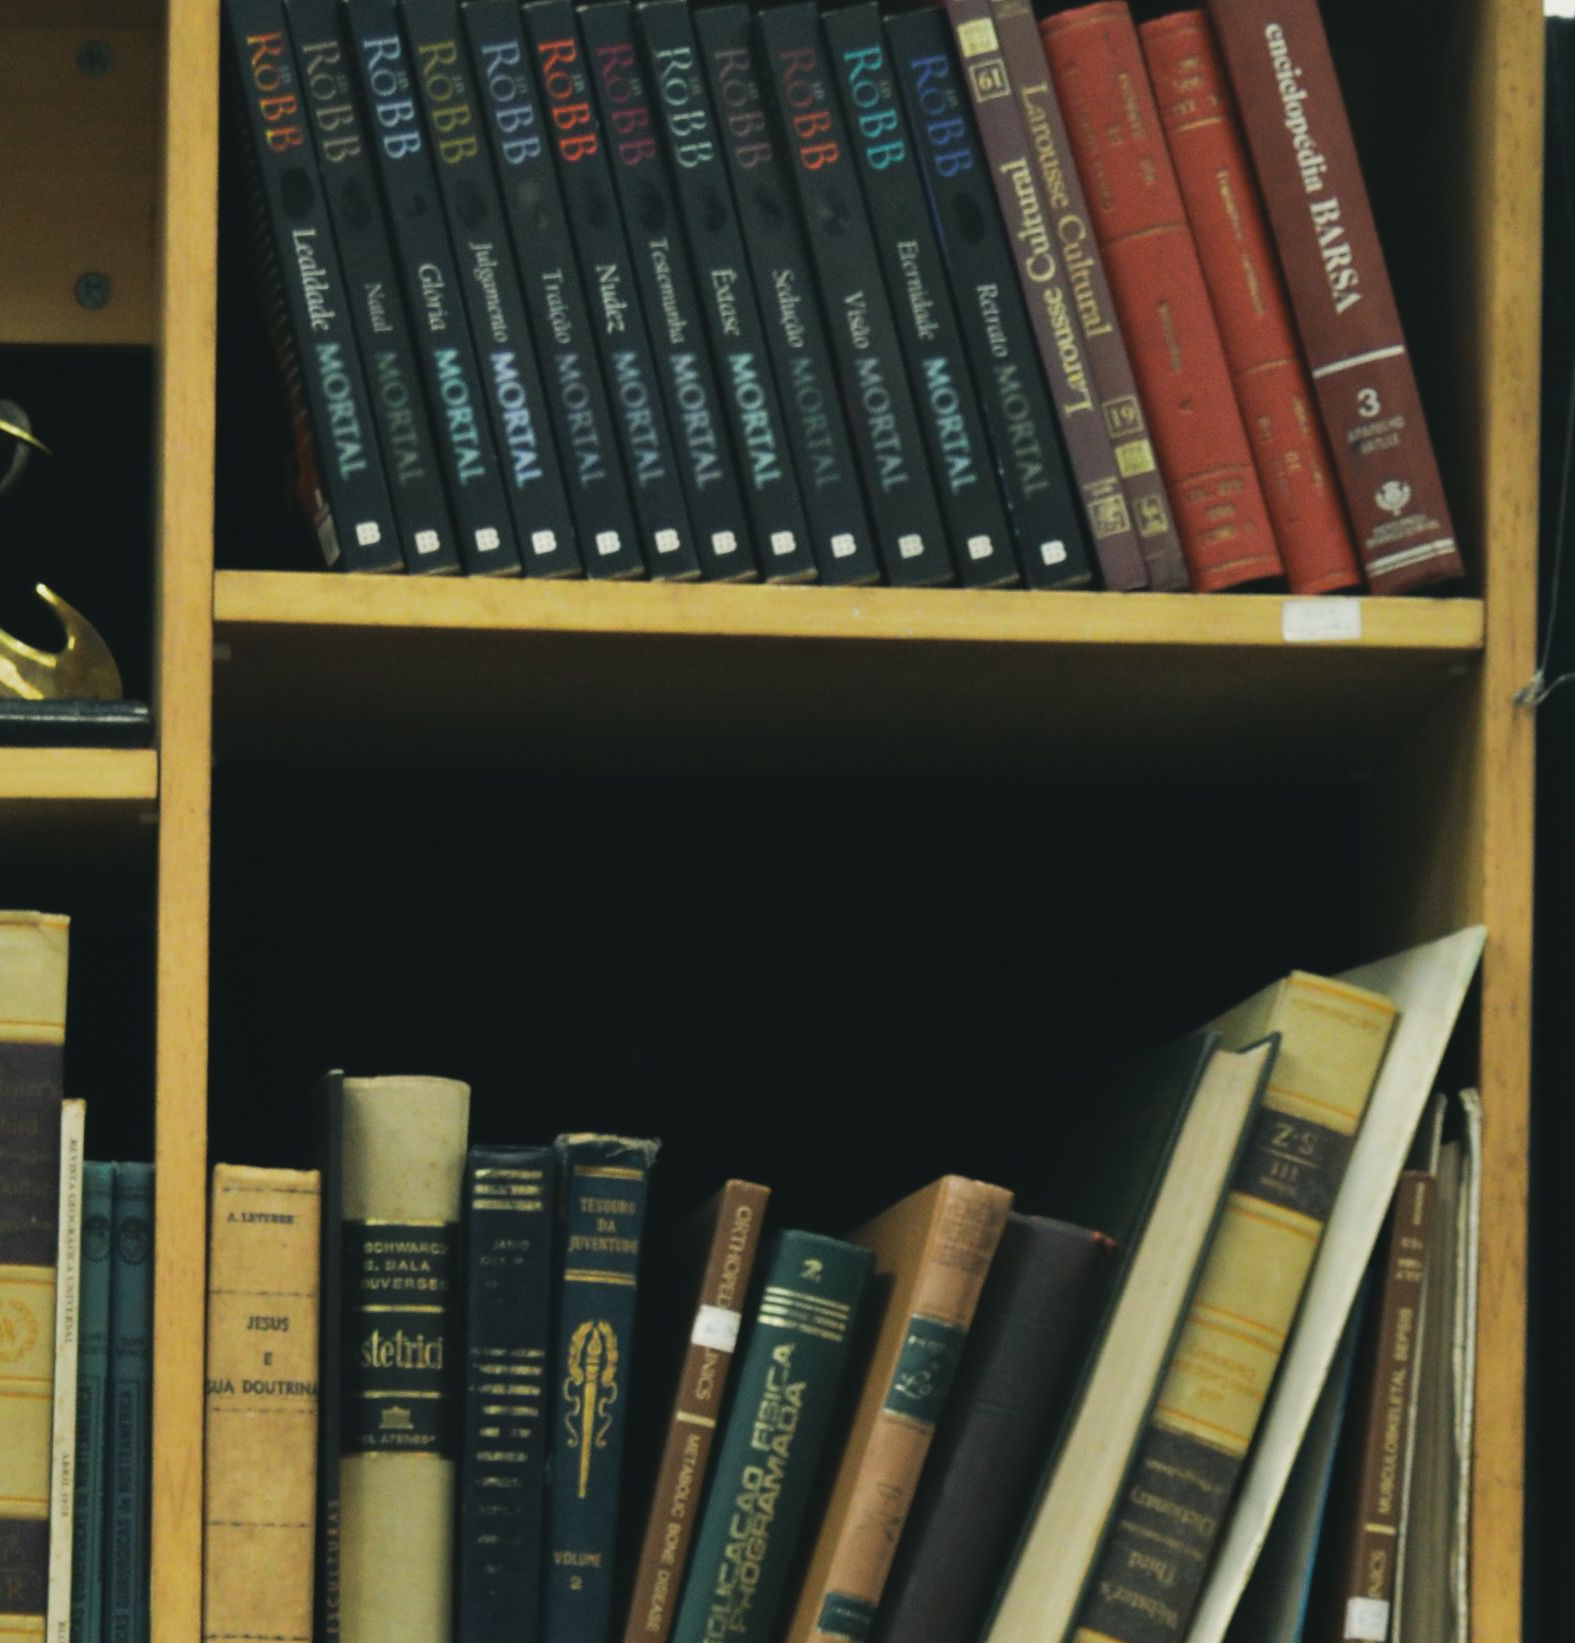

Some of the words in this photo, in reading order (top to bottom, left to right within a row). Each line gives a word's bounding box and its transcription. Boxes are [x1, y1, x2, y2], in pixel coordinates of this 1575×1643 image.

[362, 34, 422, 159] ROBB
[538, 38, 597, 162] ROBB
[844, 44, 906, 169] ROBB
[999, 157, 1058, 282] Cultural
[1019, 82, 1068, 209] Larousse
[1056, 213, 1112, 339] Cultural
[1310, 198, 1362, 314] BARSA
[1044, 280, 1093, 414] Larousse
[1356, 388, 1381, 417] 3
[490, 351, 542, 486] MORTAL
[729, 352, 781, 488] MORTAL
[921, 356, 979, 495] MORTAL
[598, 1219, 617, 1234] DA
[800, 1258, 823, 1283] 2
[247, 1316, 289, 1332] JESUS
[264, 1352, 272, 1366] E
[205, 1381, 234, 1395] SUA
[553, 1551, 604, 1567] VOLUME
[570, 1576, 583, 1591] 2
